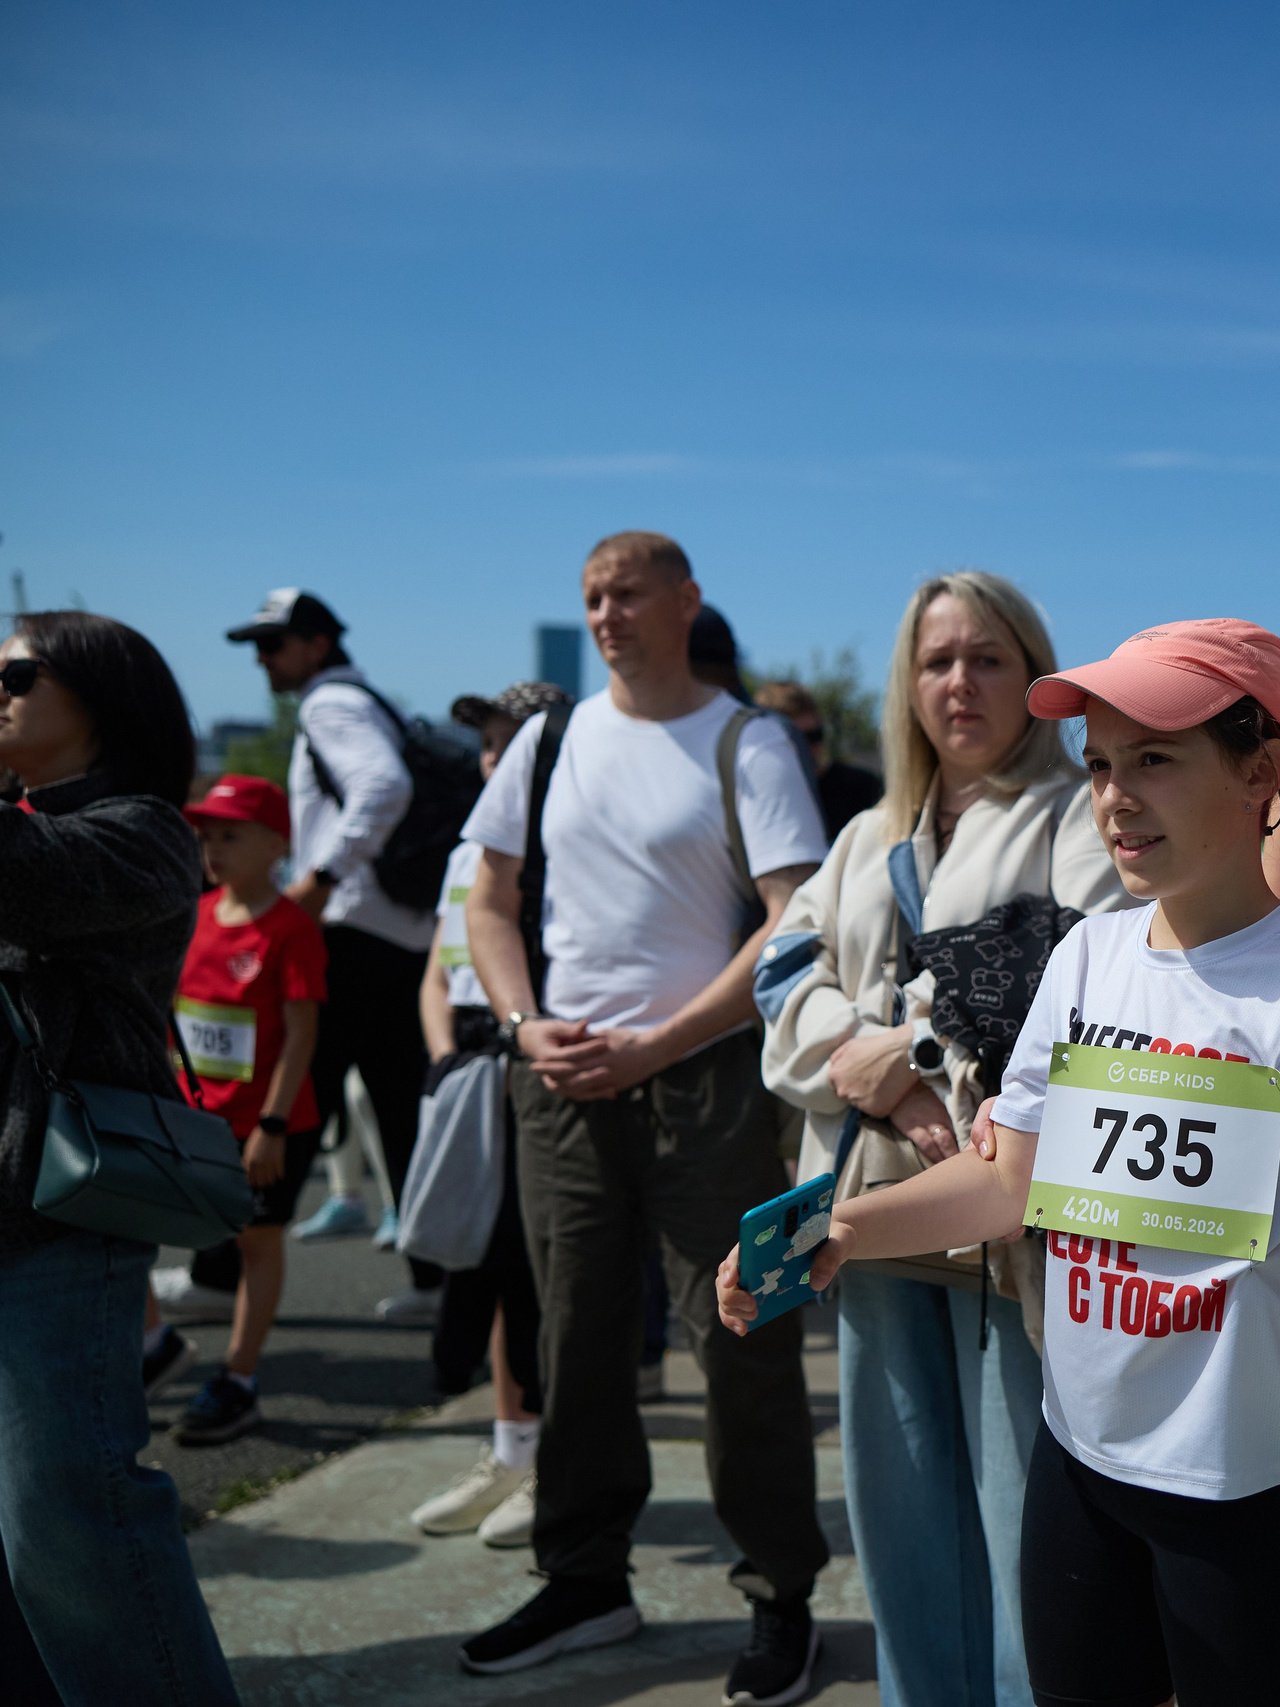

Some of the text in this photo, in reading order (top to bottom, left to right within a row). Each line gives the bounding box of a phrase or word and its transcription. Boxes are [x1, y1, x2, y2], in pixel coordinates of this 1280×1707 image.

[190, 1023, 232, 1055] 705
[1128, 1067, 1215, 1091] СБЕР KIDS
[1091, 1107, 1217, 1188] 735
[1141, 1212, 1226, 1237] 30.05.2026
[1068, 1266, 1229, 1338] С ТОБОЙ
